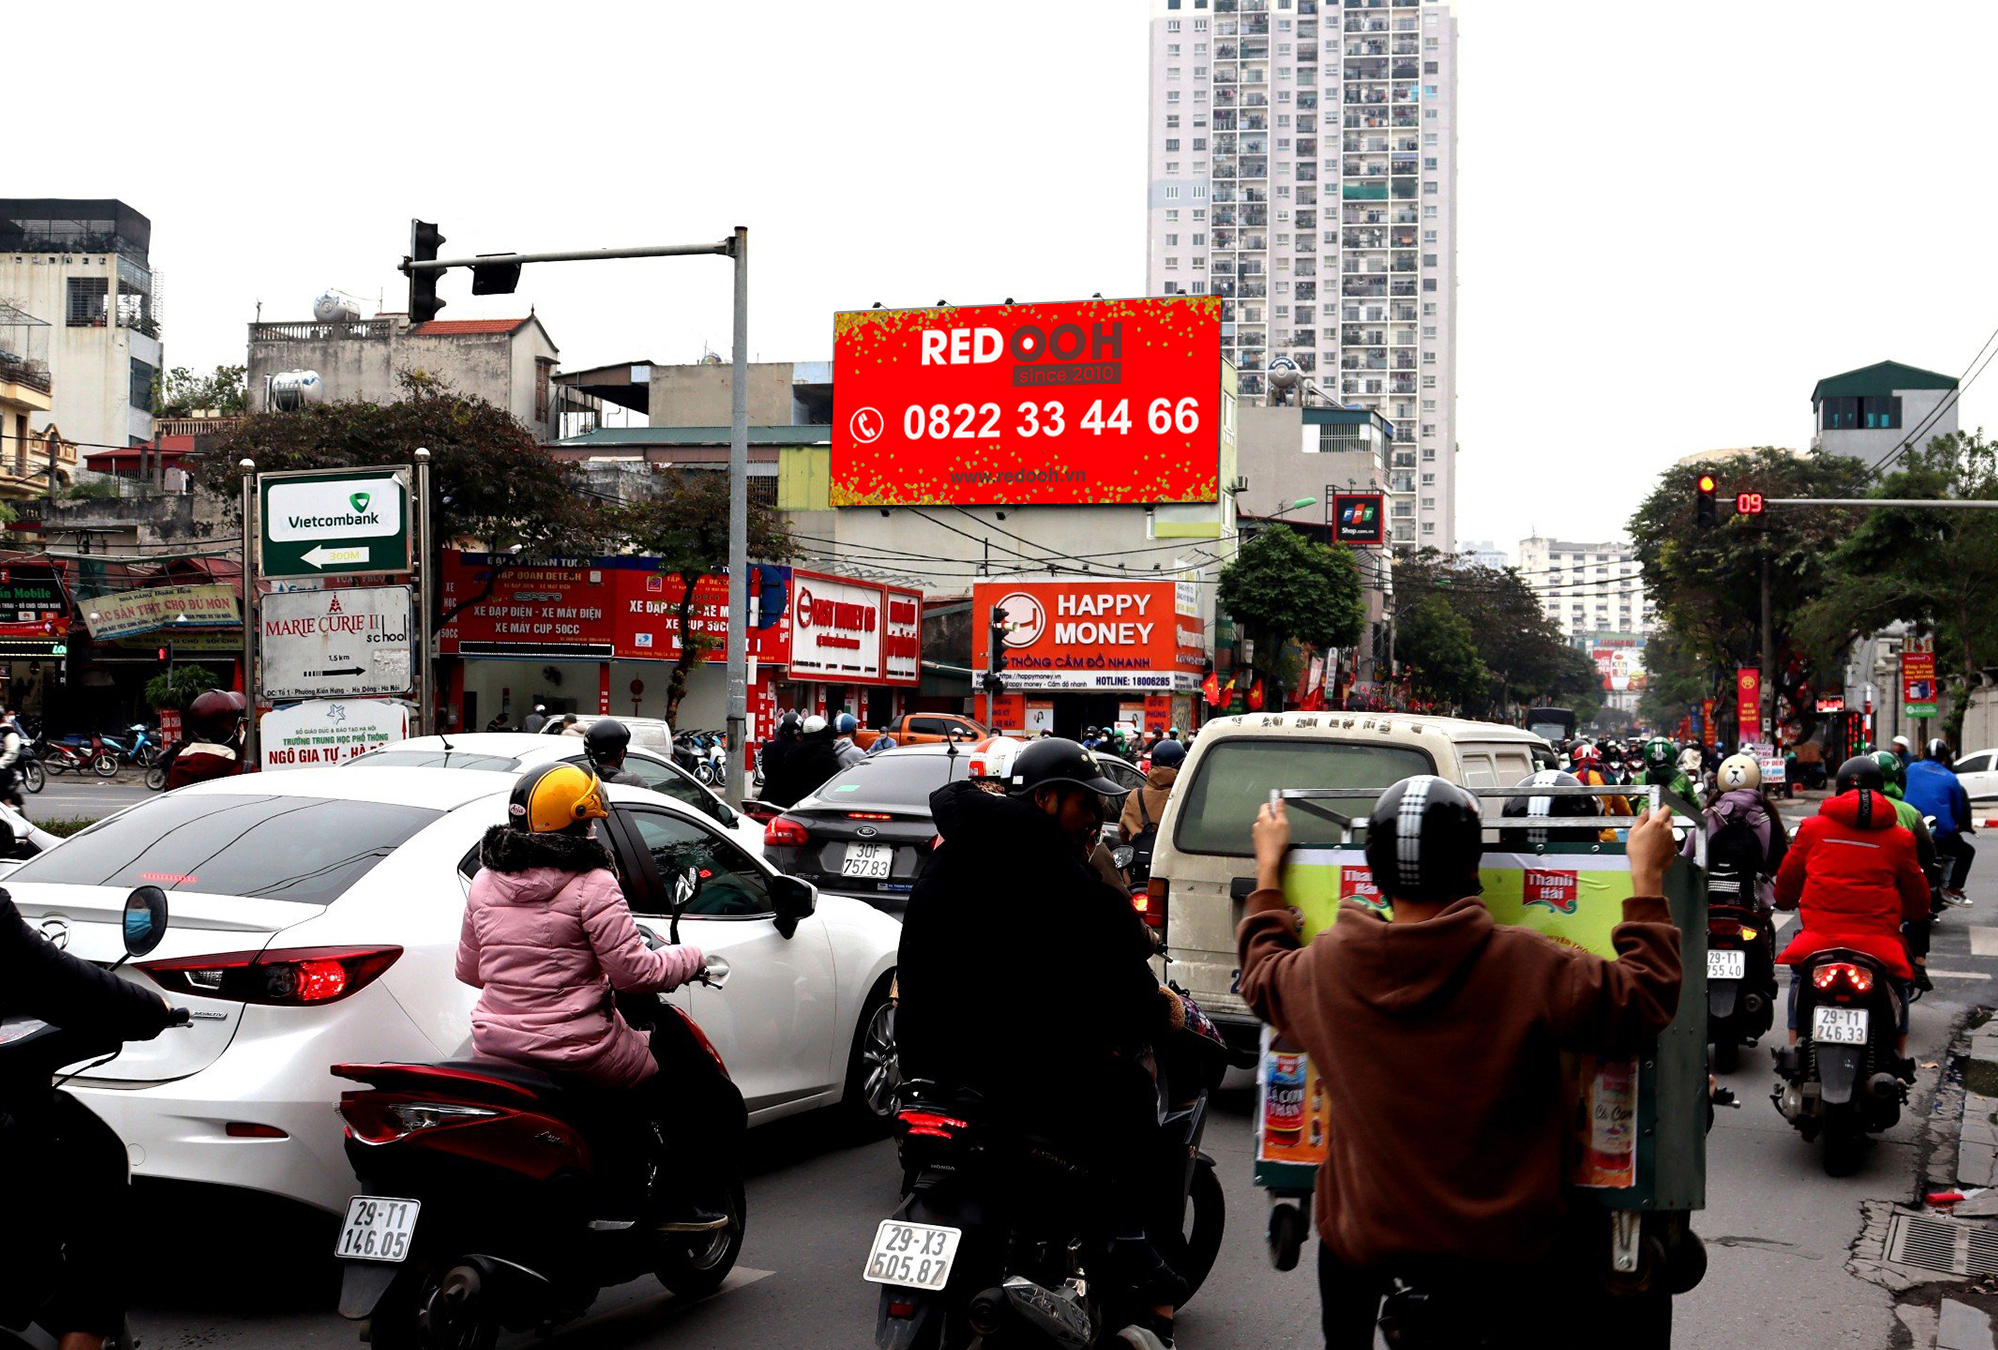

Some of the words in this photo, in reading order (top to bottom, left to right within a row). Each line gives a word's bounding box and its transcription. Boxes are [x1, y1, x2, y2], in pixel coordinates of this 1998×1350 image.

[1019, 367, 1067, 383] since
[1073, 366, 1114, 381] 2010
[904, 402, 1001, 440] 0822
[1016, 400, 1066, 438] 33
[1080, 398, 1132, 436] 44
[1147, 397, 1200, 435] 66
[950, 467, 1086, 484] www.redooh.vn
[1738, 493, 1762, 513] 09
[288, 512, 380, 529] Vietcombank
[330, 551, 360, 561] 300M
[15, 588, 51, 599] Mobile
[474, 606, 486, 616] XE
[488, 606, 508, 618] ĐẠP
[510, 605, 533, 620] ĐIỆN
[541, 608, 554, 618] XE
[556, 606, 577, 618] MÁY
[579, 607, 602, 621] ĐIỆN
[629, 600, 643, 612] XE
[1057, 594, 1151, 616] HAPPY
[265, 618, 315, 638] MARIE
[318, 615, 365, 635] CURIE
[366, 613, 407, 643] school
[495, 622, 508, 633] XE
[510, 621, 531, 633] MÁY
[533, 624, 553, 634] CUP
[555, 624, 580, 635] 50CC
[665, 618, 679, 629] XE
[1055, 622, 1155, 645] MONEY
[1108, 657, 1152, 668] NHANH
[1095, 676, 1130, 686] HOTLINE:
[1132, 676, 1170, 687] 18006285
[312, 736, 335, 745] TRUNG
[336, 735, 351, 745] HỌC
[269, 747, 298, 765] NGÔ
[299, 748, 320, 763] GIA
[322, 746, 340, 765] TỰ
[856, 843, 882, 859] 30F
[843, 859, 888, 876] 757.83
[1528, 874, 1574, 886] Thanh
[1709, 952, 1738, 964] 29-T1
[1822, 1009, 1859, 1027] 29-T1
[1817, 1025, 1864, 1042] 246.33
[353, 1201, 408, 1229] 29-T1
[344, 1228, 408, 1258] 146.05
[886, 1226, 947, 1256] 29-X3
[872, 1253, 947, 1285] 505.87
